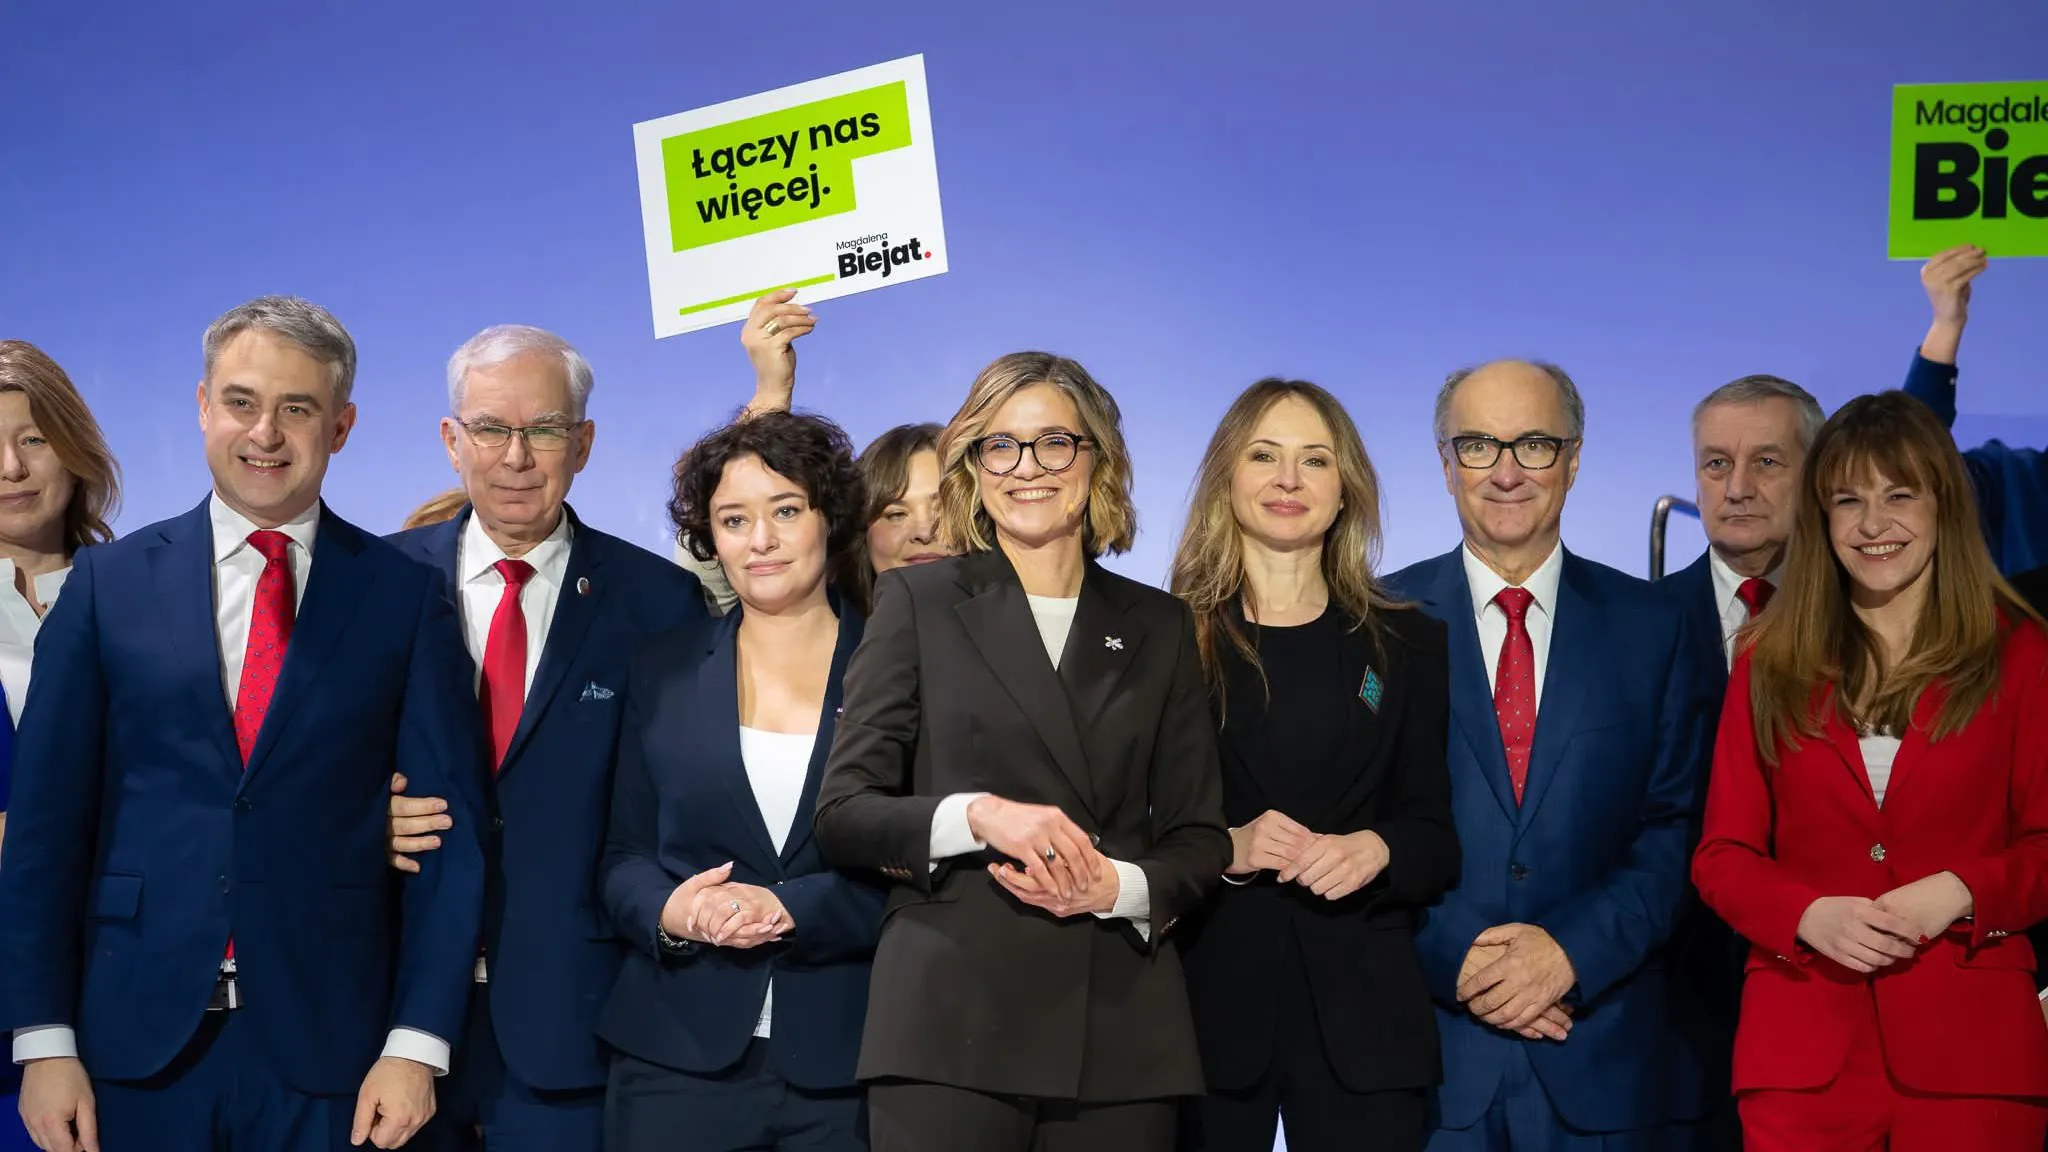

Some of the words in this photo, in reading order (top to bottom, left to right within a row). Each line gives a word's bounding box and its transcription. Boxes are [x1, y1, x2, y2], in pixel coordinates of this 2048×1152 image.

[691, 131, 800, 180] Łączy
[808, 112, 881, 151] nas
[695, 163, 831, 224] więcej.
[835, 232, 889, 252] Magdalena
[837, 237, 932, 279] Biejat.
